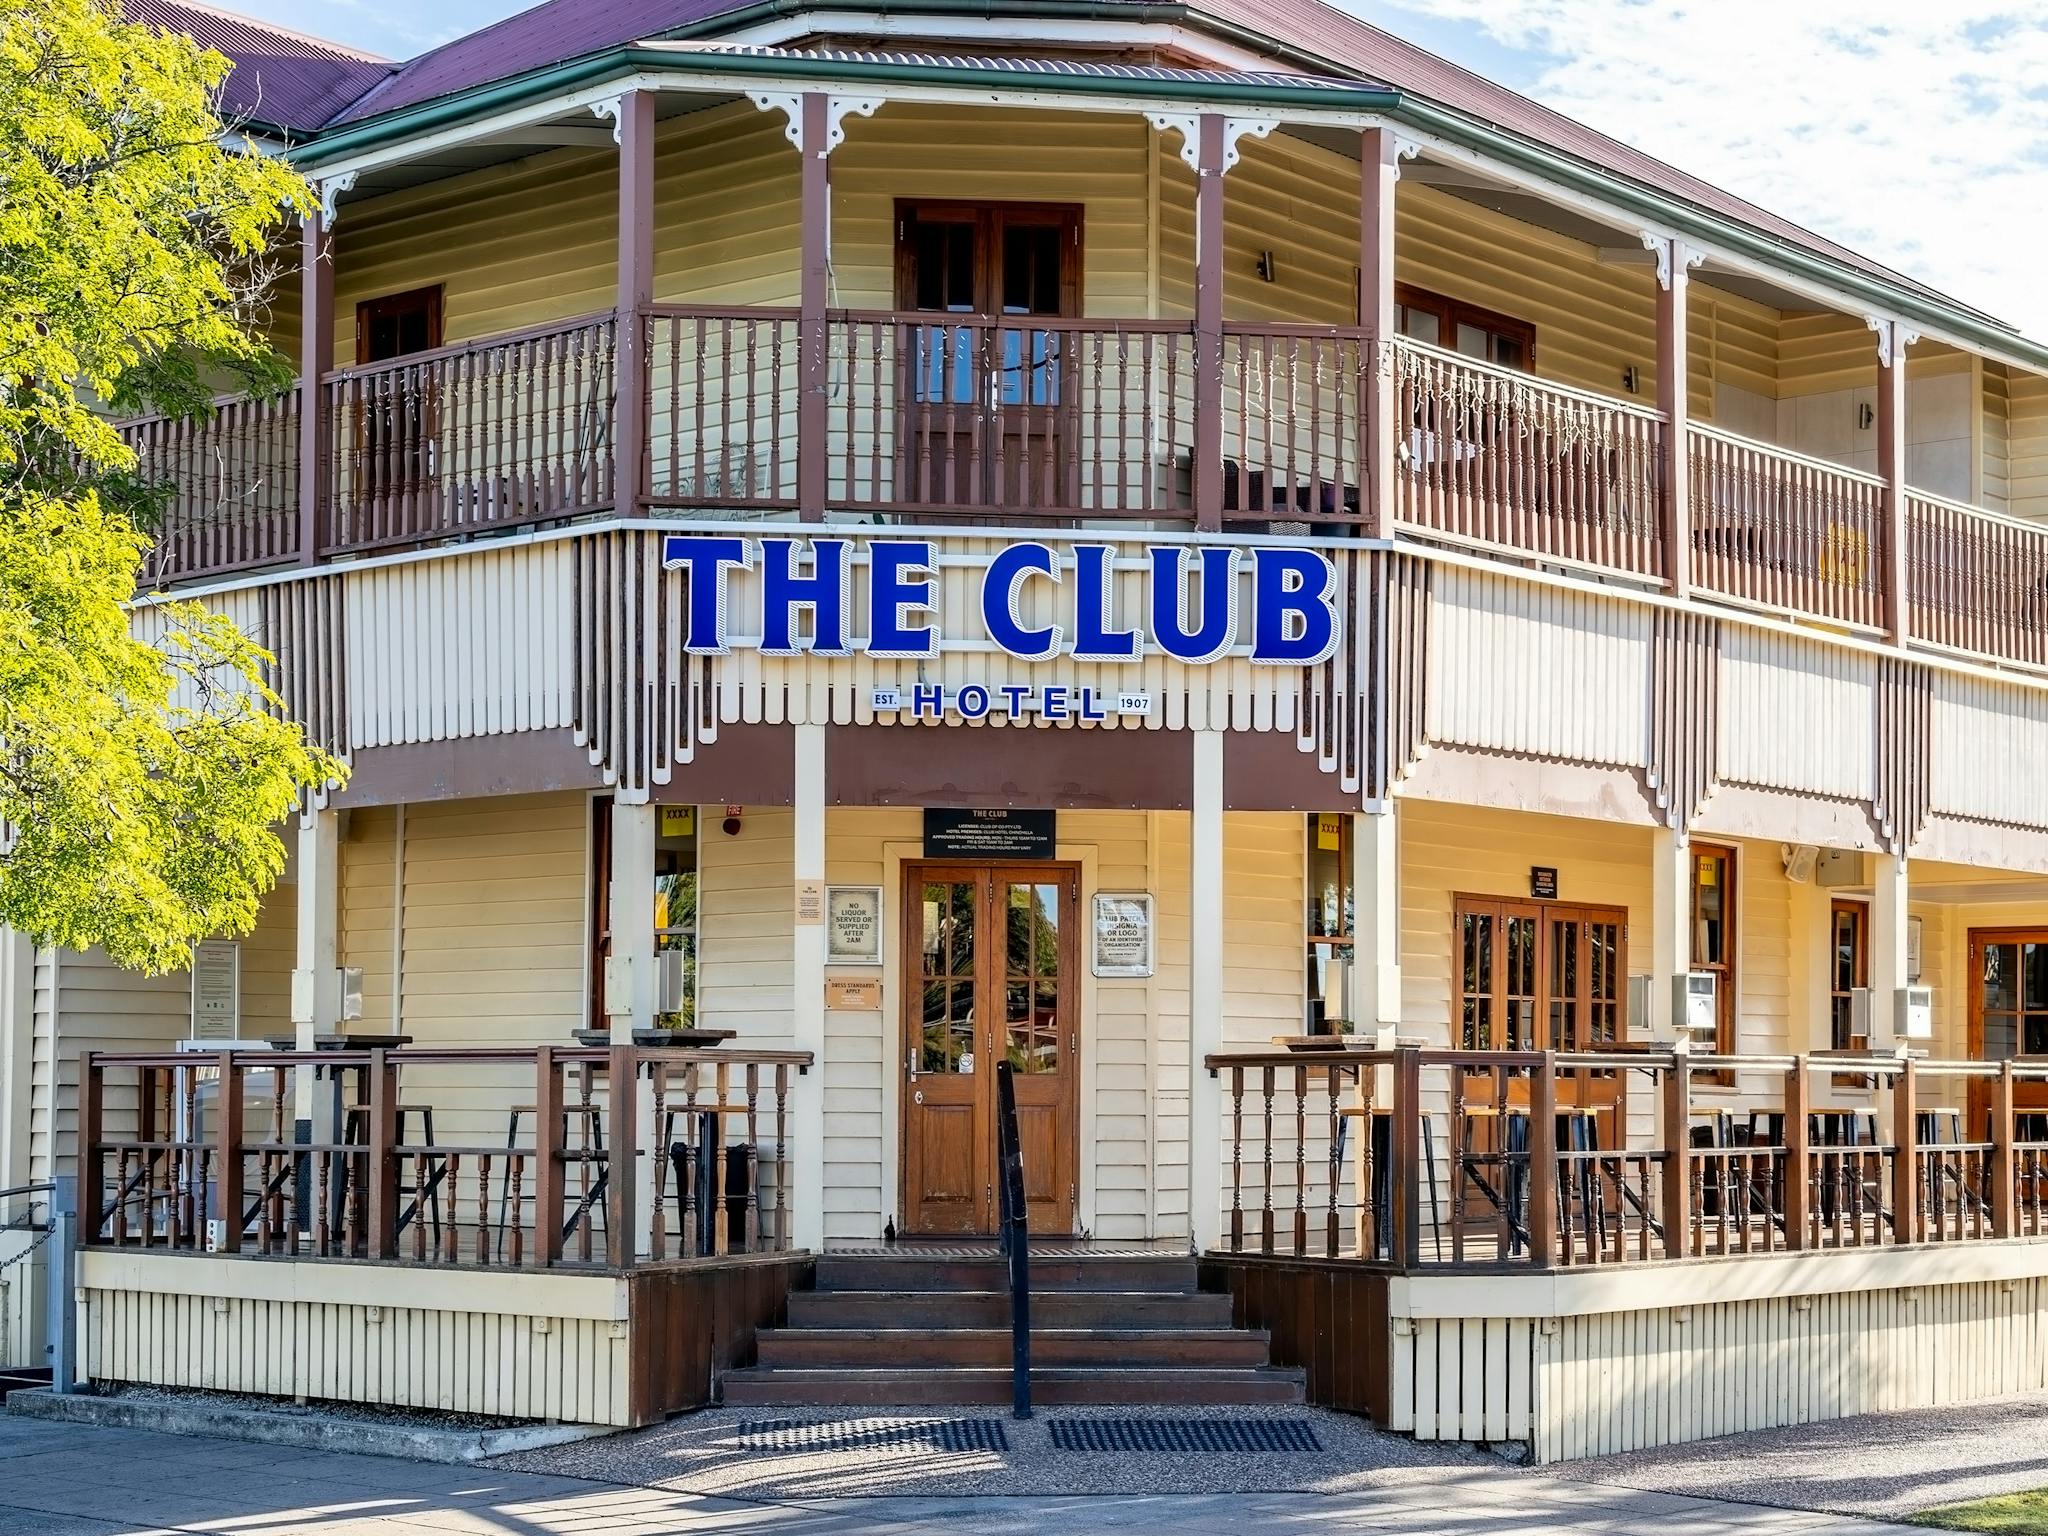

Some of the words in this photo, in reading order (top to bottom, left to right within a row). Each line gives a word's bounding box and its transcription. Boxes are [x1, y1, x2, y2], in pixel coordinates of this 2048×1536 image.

[663, 536, 941, 659] THE
[980, 541, 1342, 665] CLUB
[875, 694, 897, 705] EST.
[912, 683, 1107, 721] HOTEL
[1121, 698, 1149, 709] 1907
[666, 808, 689, 819] XXXX
[1321, 823, 1340, 833] XXXX
